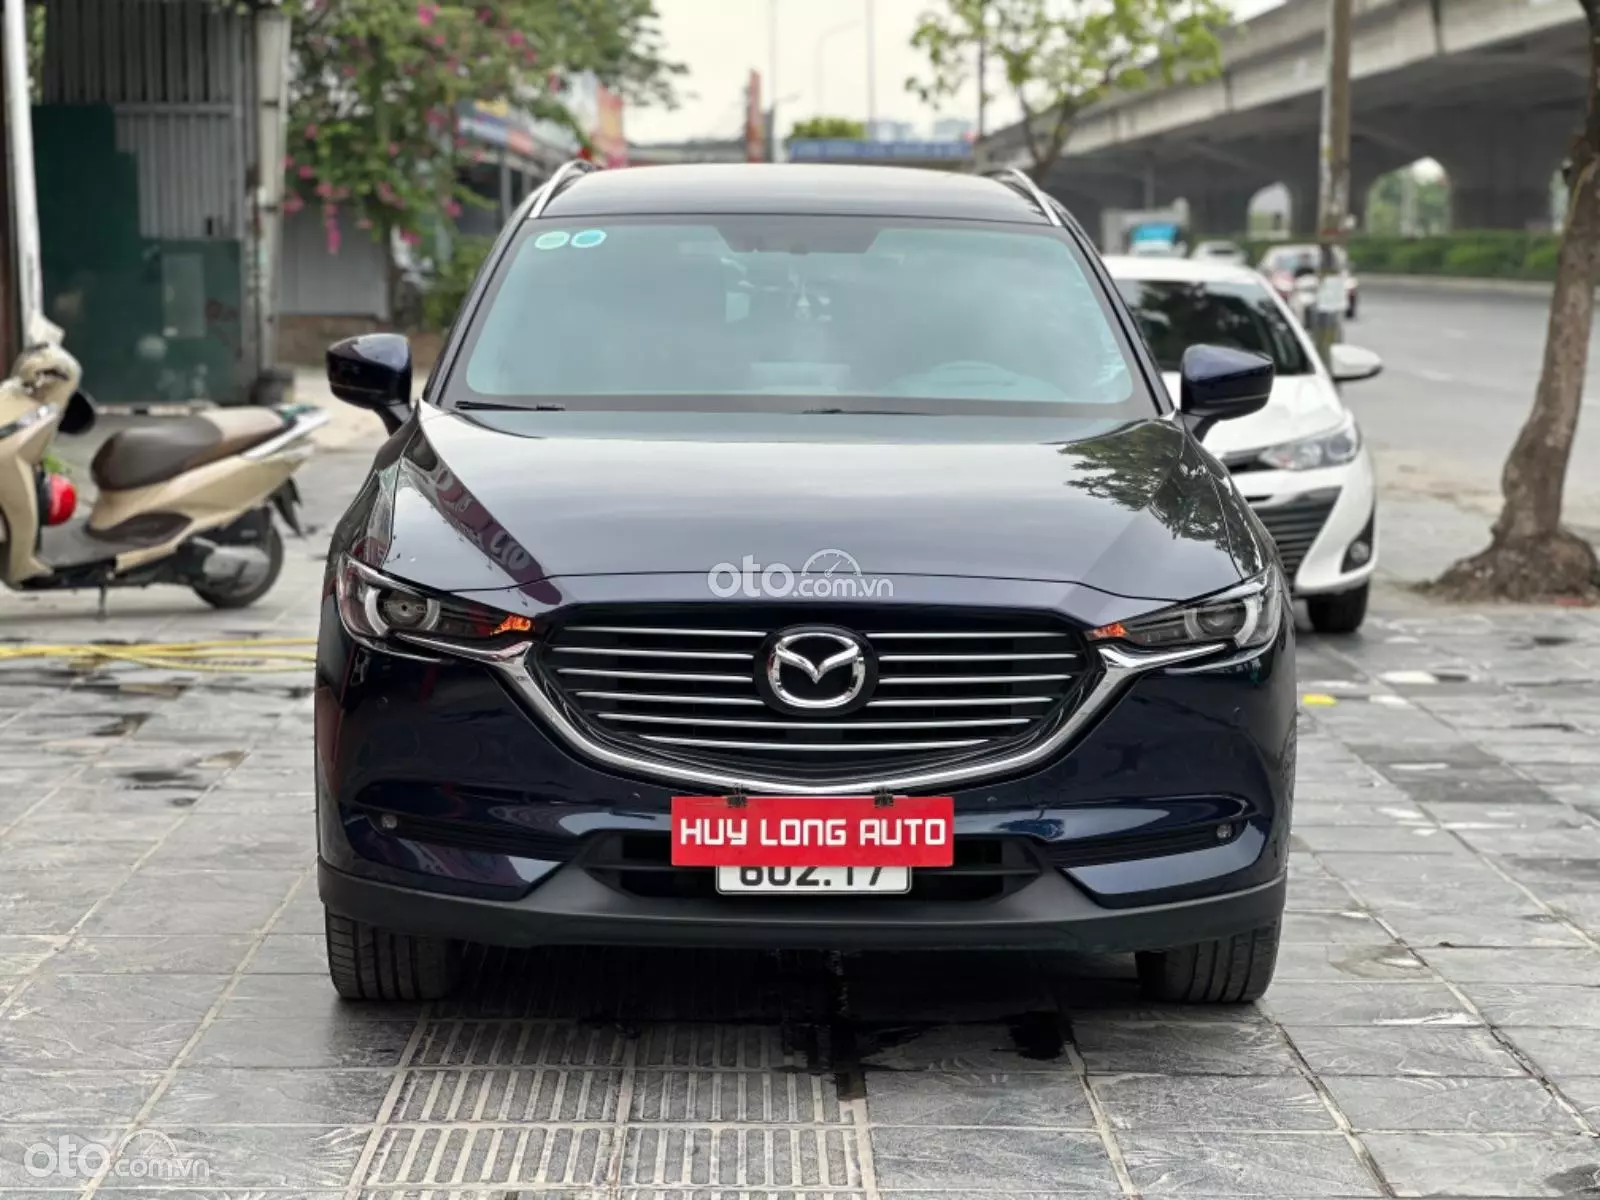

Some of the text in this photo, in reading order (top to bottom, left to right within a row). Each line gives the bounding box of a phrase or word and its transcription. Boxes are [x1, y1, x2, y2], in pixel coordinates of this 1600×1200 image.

[680, 818, 946, 846] HUY LONG AUTO
